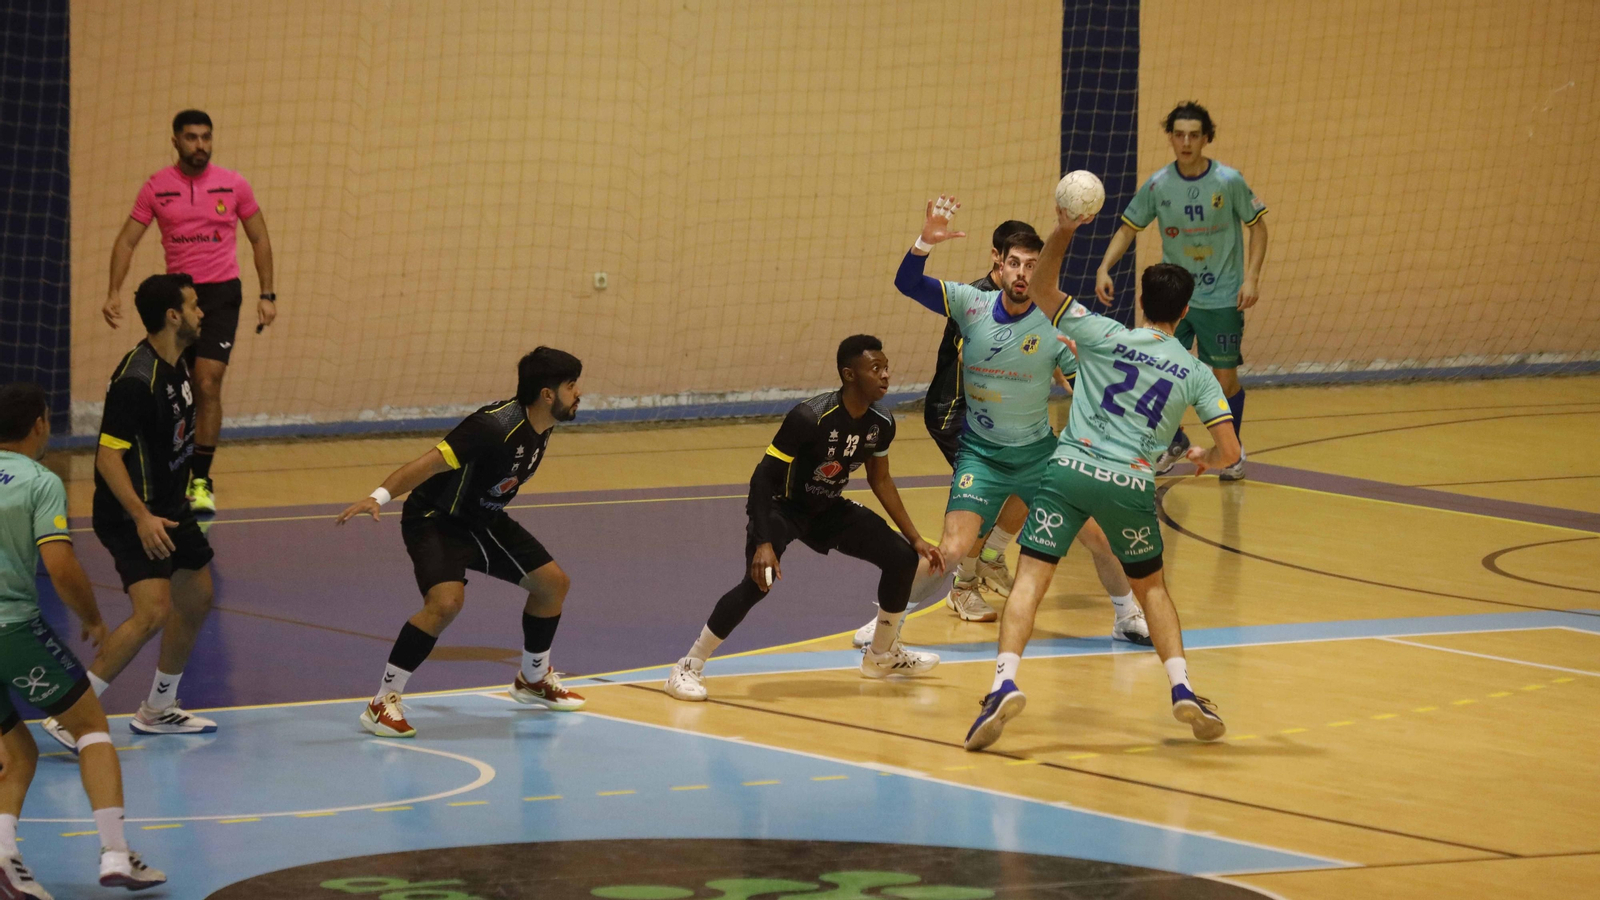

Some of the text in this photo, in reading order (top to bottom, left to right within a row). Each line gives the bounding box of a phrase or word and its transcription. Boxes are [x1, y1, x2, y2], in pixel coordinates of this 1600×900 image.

[1184, 205, 1204, 221] 99
[171, 233, 210, 243] helvetia
[1216, 332, 1240, 354] 99
[984, 347, 1003, 361] 7
[1112, 343, 1190, 380] PAREJAS
[1100, 359, 1174, 430] 24
[843, 434, 860, 457] 23
[1057, 457, 1147, 492] SILBON
[1028, 534, 1057, 549] SILBON
[1124, 545, 1154, 556] SILBON
